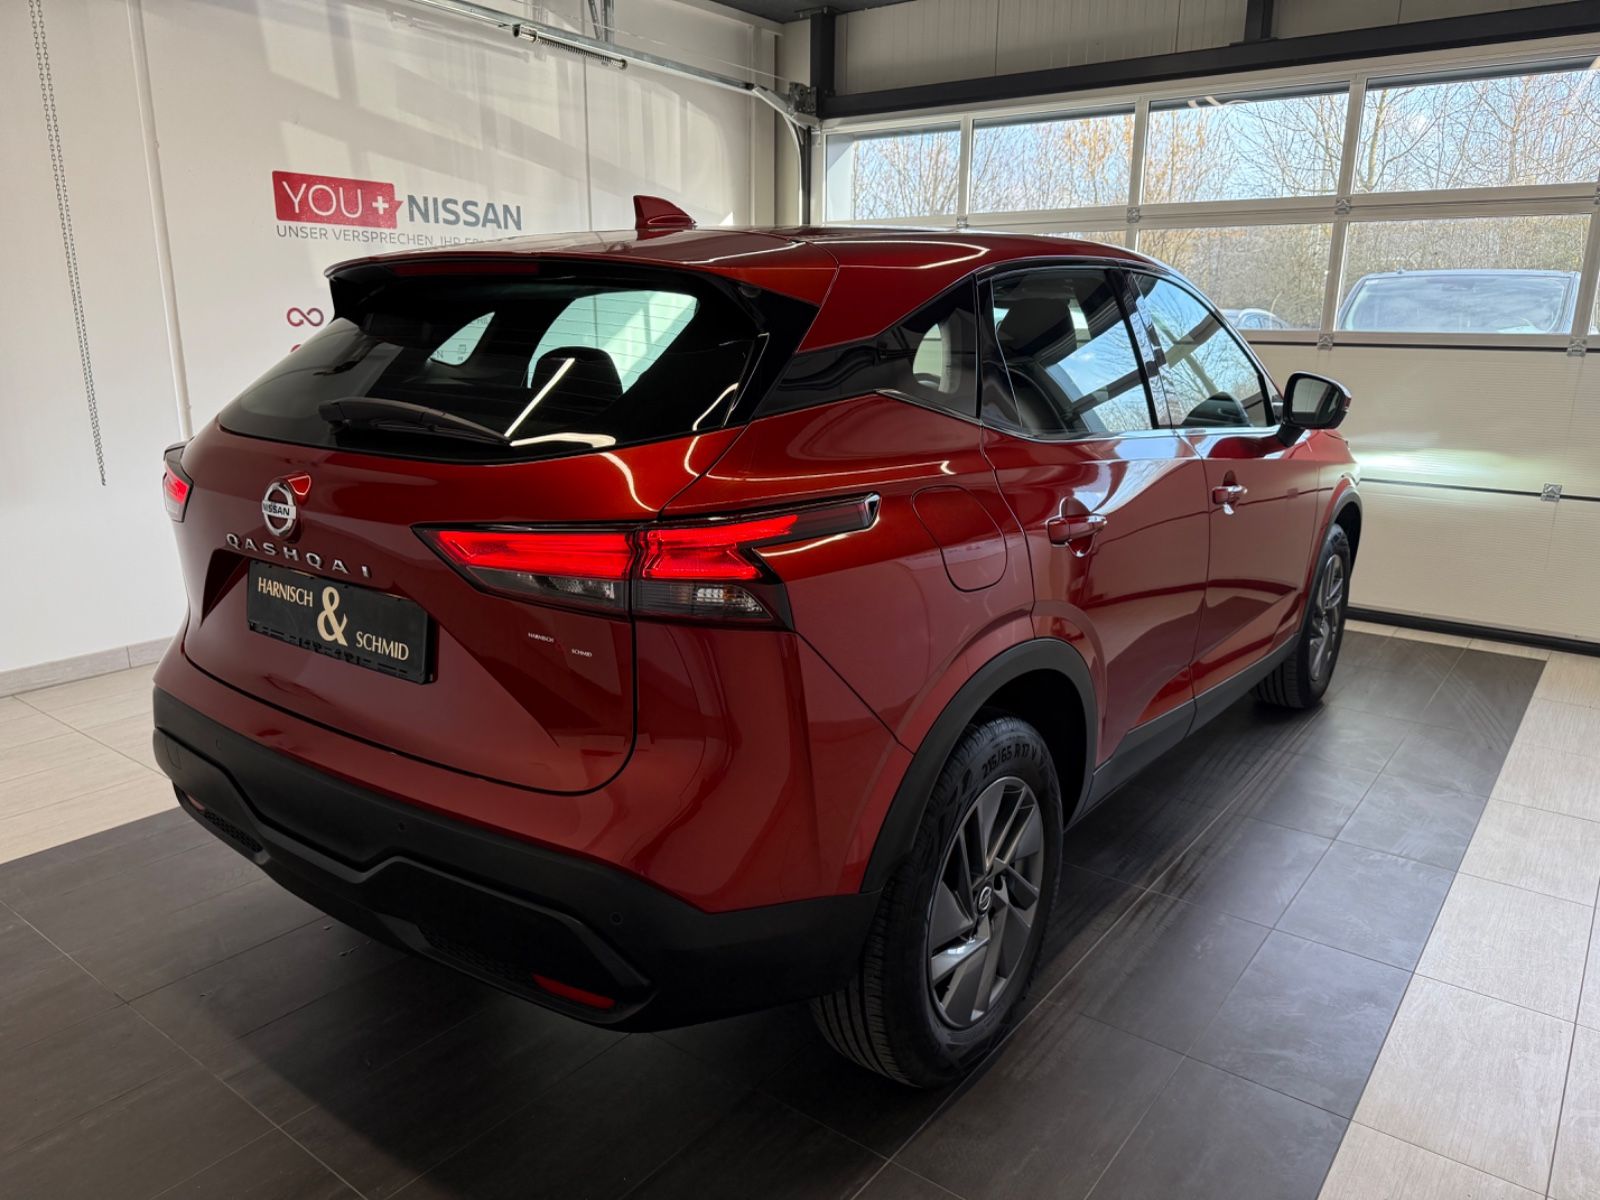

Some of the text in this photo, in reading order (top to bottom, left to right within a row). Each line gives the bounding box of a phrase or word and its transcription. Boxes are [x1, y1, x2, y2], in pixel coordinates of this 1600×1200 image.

[282, 181, 362, 218] YOU
[407, 194, 522, 231] NISSAN
[276, 225, 329, 240] UNSER
[263, 503, 290, 517] NISSAN
[226, 533, 370, 578] QASHQAI
[258, 577, 409, 661] HARNISCH & SCHMID
[571, 648, 592, 657] SCHMID
